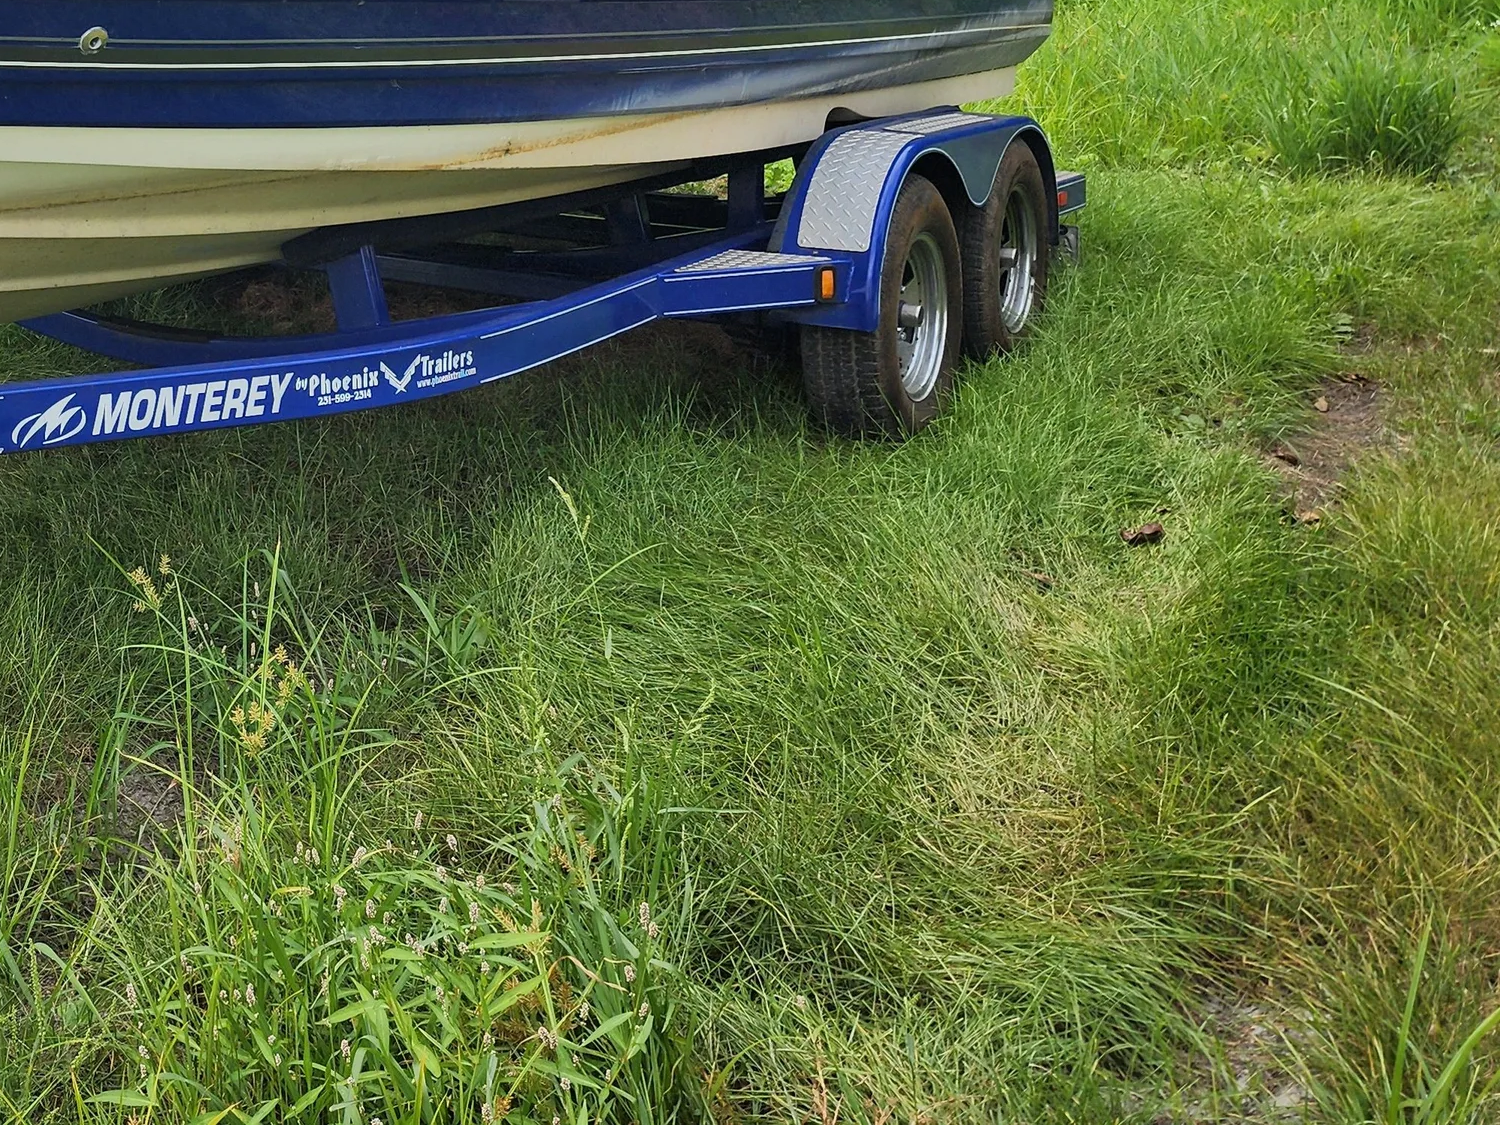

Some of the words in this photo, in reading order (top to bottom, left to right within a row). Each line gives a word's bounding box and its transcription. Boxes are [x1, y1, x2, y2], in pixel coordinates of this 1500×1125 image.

[92, 372, 295, 436] MONTEREY
[295, 376, 308, 391] by
[309, 366, 379, 396] Phoenix
[420, 350, 474, 377] Trailers
[317, 388, 372, 406] 231-599-2314
